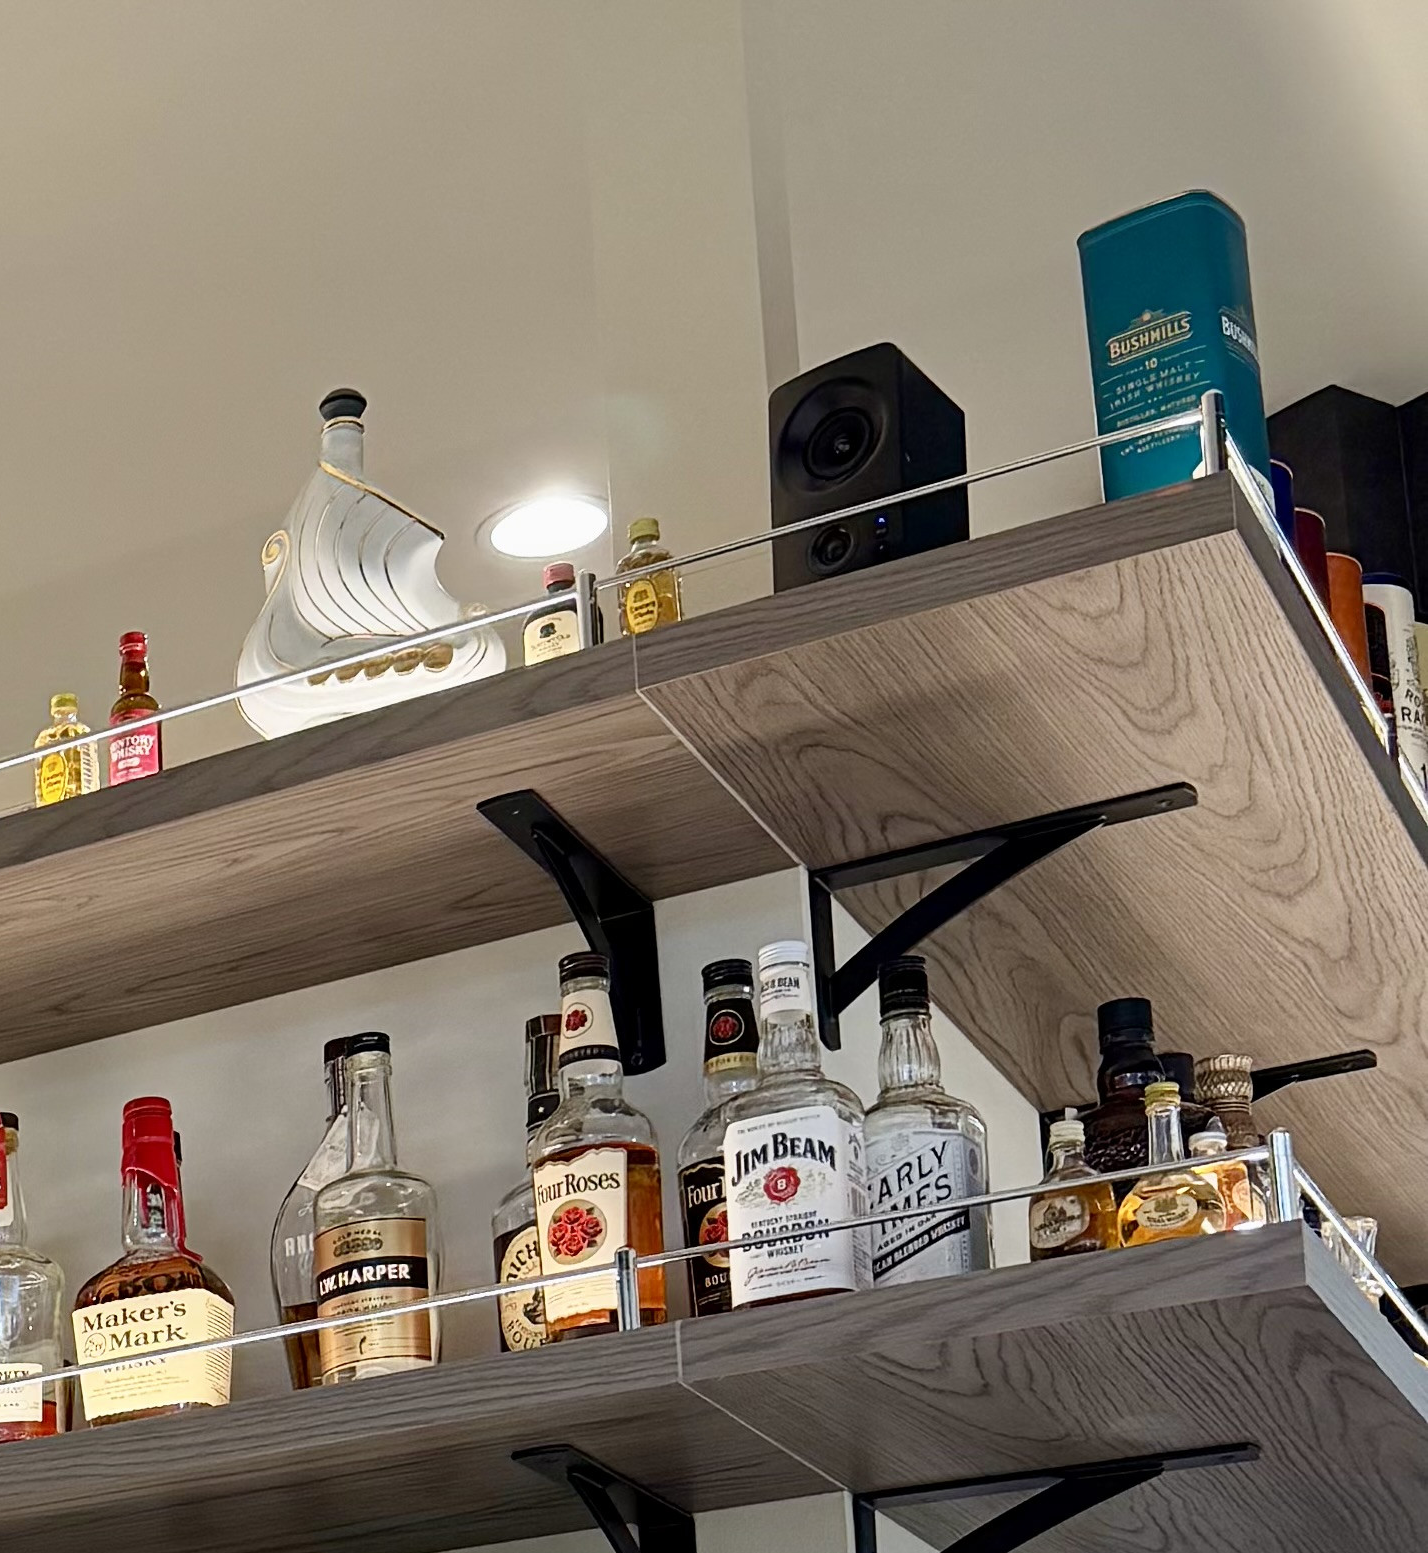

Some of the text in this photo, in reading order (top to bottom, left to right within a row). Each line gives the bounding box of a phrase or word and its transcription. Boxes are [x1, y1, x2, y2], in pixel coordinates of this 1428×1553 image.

[1109, 319, 1190, 359] BUSHMILLS
[1115, 362, 1190, 395] SINGLE MALT
[1145, 372, 1200, 393] WHISKEY
[731, 1132, 838, 1187] JIM BEAM
[537, 1169, 621, 1205] Four Roses
[930, 1215, 968, 1244] WHISKEY
[767, 1243, 804, 1259] WHISKEY
[339, 1263, 412, 1286] HARPER
[81, 1300, 187, 1335] Maker's
[109, 1323, 186, 1352] Mark
